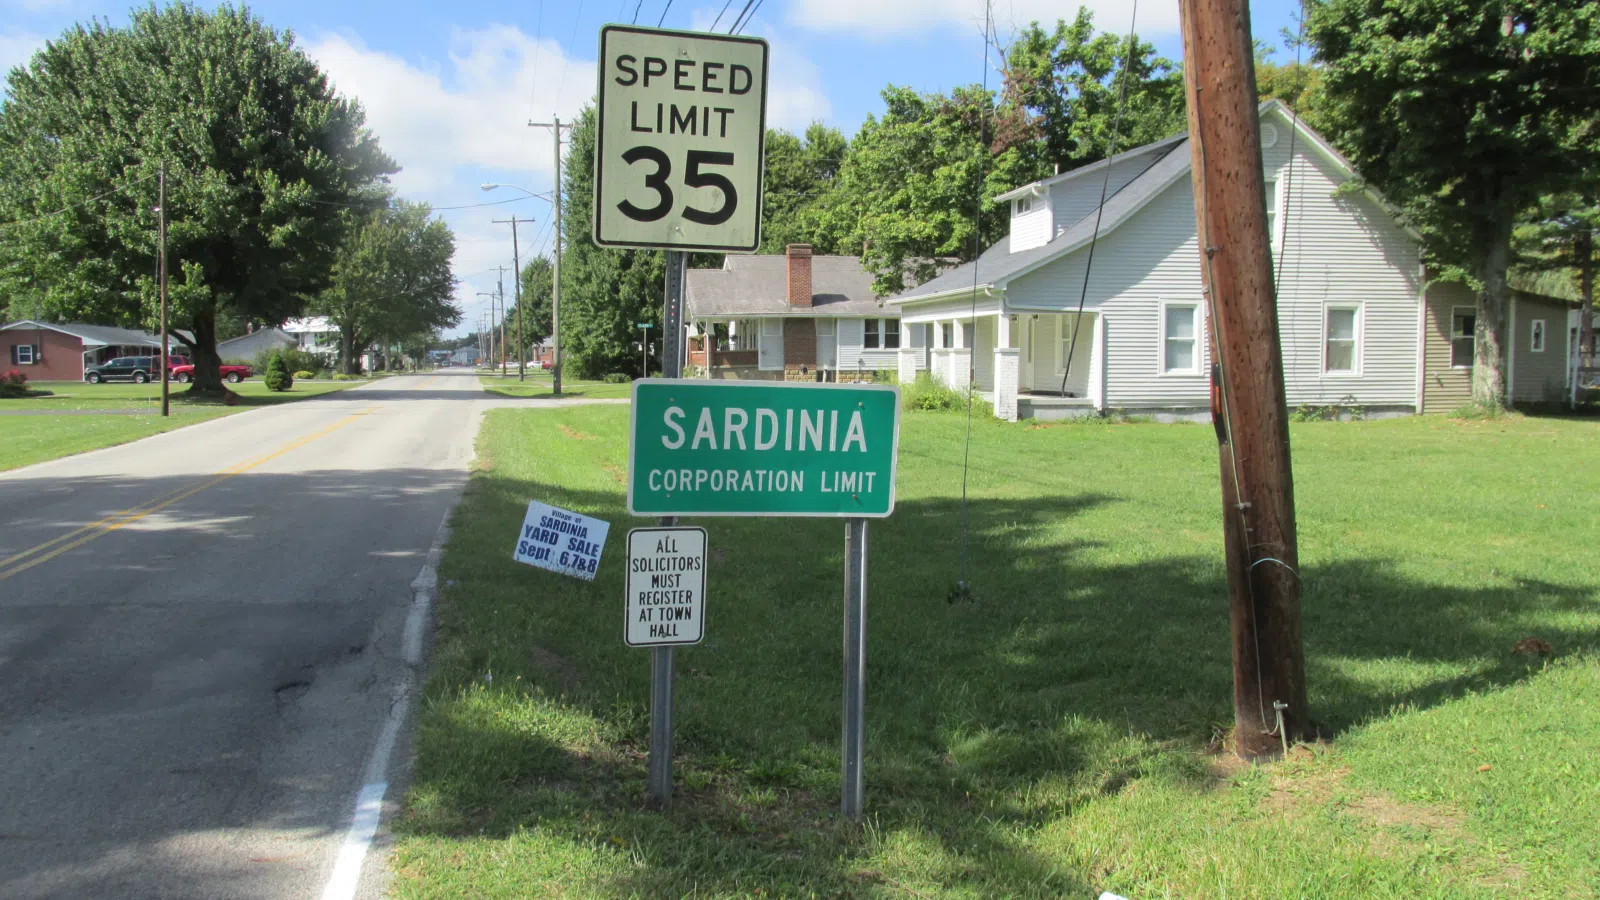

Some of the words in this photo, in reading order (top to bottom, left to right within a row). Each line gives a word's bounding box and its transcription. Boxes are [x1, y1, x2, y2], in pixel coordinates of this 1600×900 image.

[615, 54, 753, 95] SPEED
[631, 101, 735, 138] LIMIT
[616, 145, 738, 226] 35
[661, 406, 867, 452] SARDINIA
[649, 469, 804, 492] CORPORATION
[821, 471, 876, 493] LIMIT
[540, 515, 588, 539] SARDINIA
[551, 510, 572, 521] Village
[525, 524, 559, 545] YARD
[567, 537, 600, 557] SALE
[656, 538, 679, 554] ALL
[518, 540, 551, 561] Sept
[559, 551, 598, 573] 6,7&8
[632, 556, 701, 573] SOLICITORS
[651, 574, 682, 589] MUST
[639, 590, 693, 606] REGISTER
[639, 608, 654, 623] AT
[658, 606, 692, 622] TOWN
[649, 623, 679, 638] HALL
